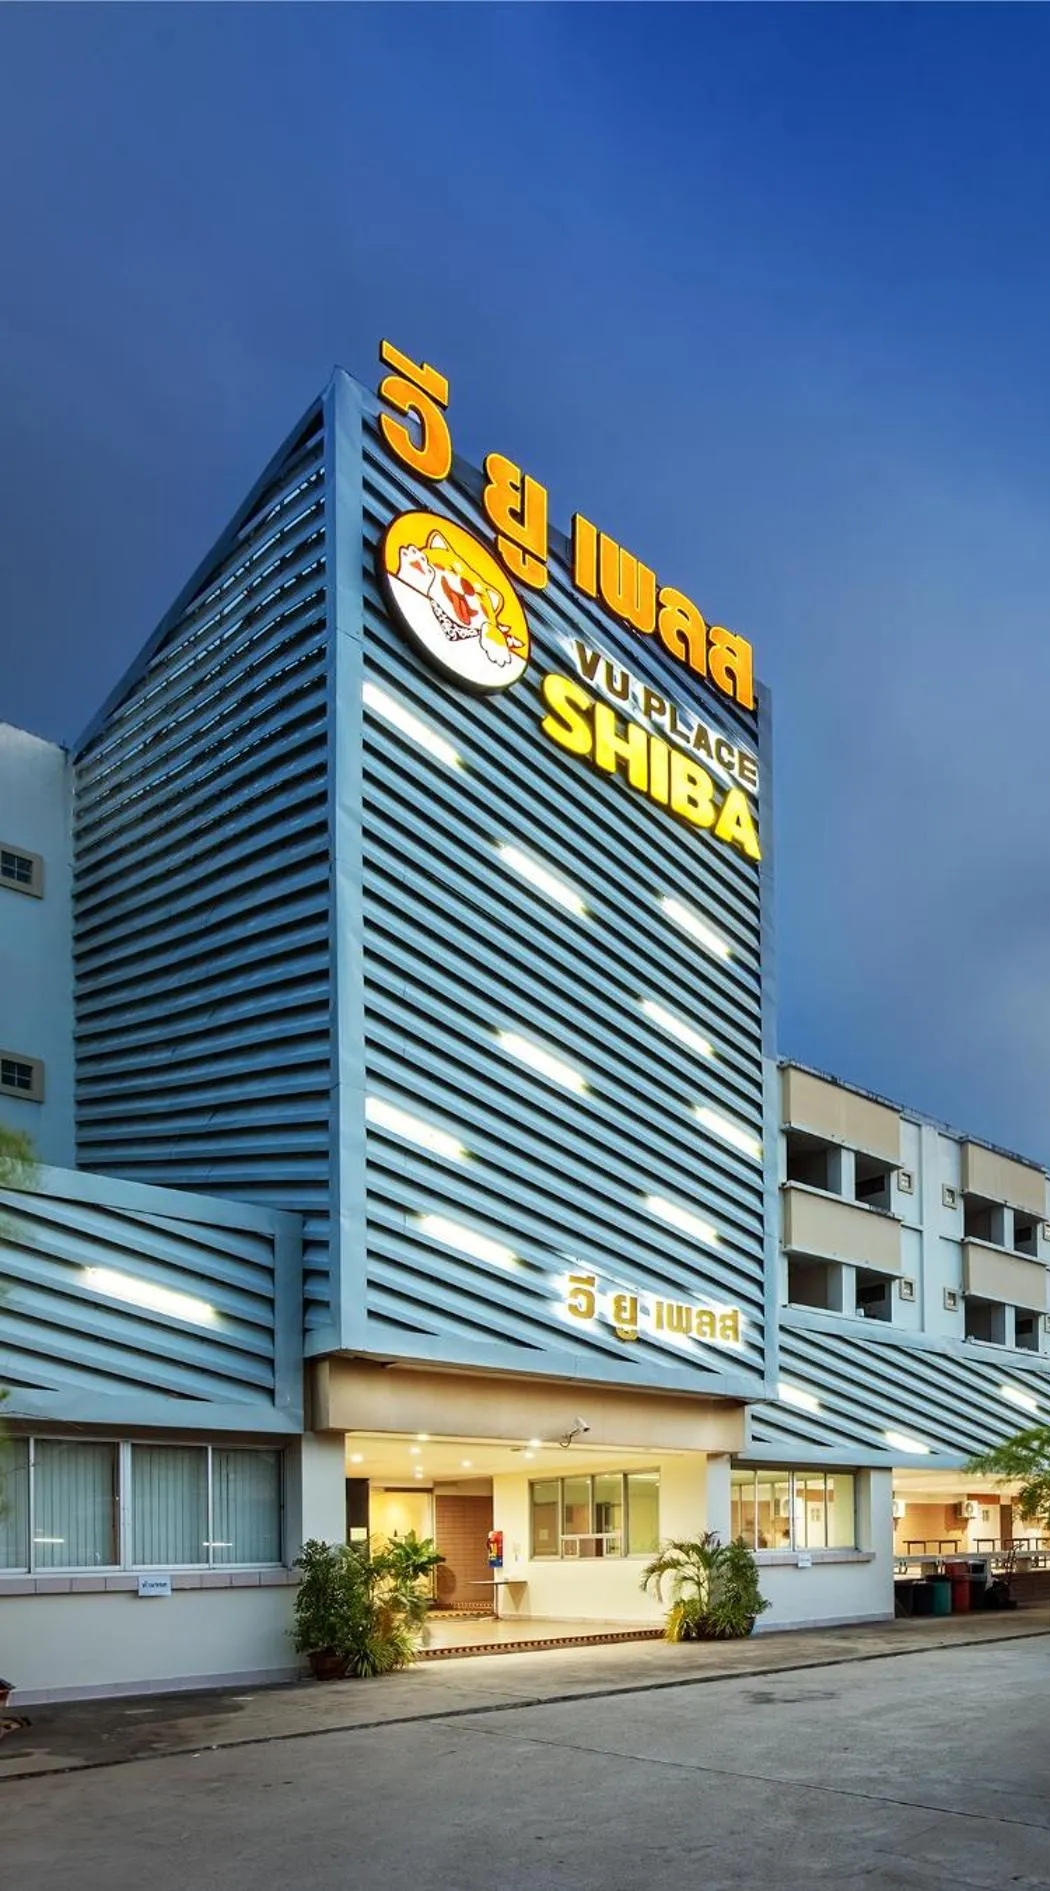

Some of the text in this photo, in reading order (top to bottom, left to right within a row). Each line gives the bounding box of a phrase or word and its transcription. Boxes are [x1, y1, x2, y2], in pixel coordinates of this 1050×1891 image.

[378, 339, 756, 711] วี ยู เพลส
[540, 672, 762, 863] SHIBA
[574, 640, 759, 787] VU PLACE
[567, 1275, 741, 1344] วี ยู เพลส
